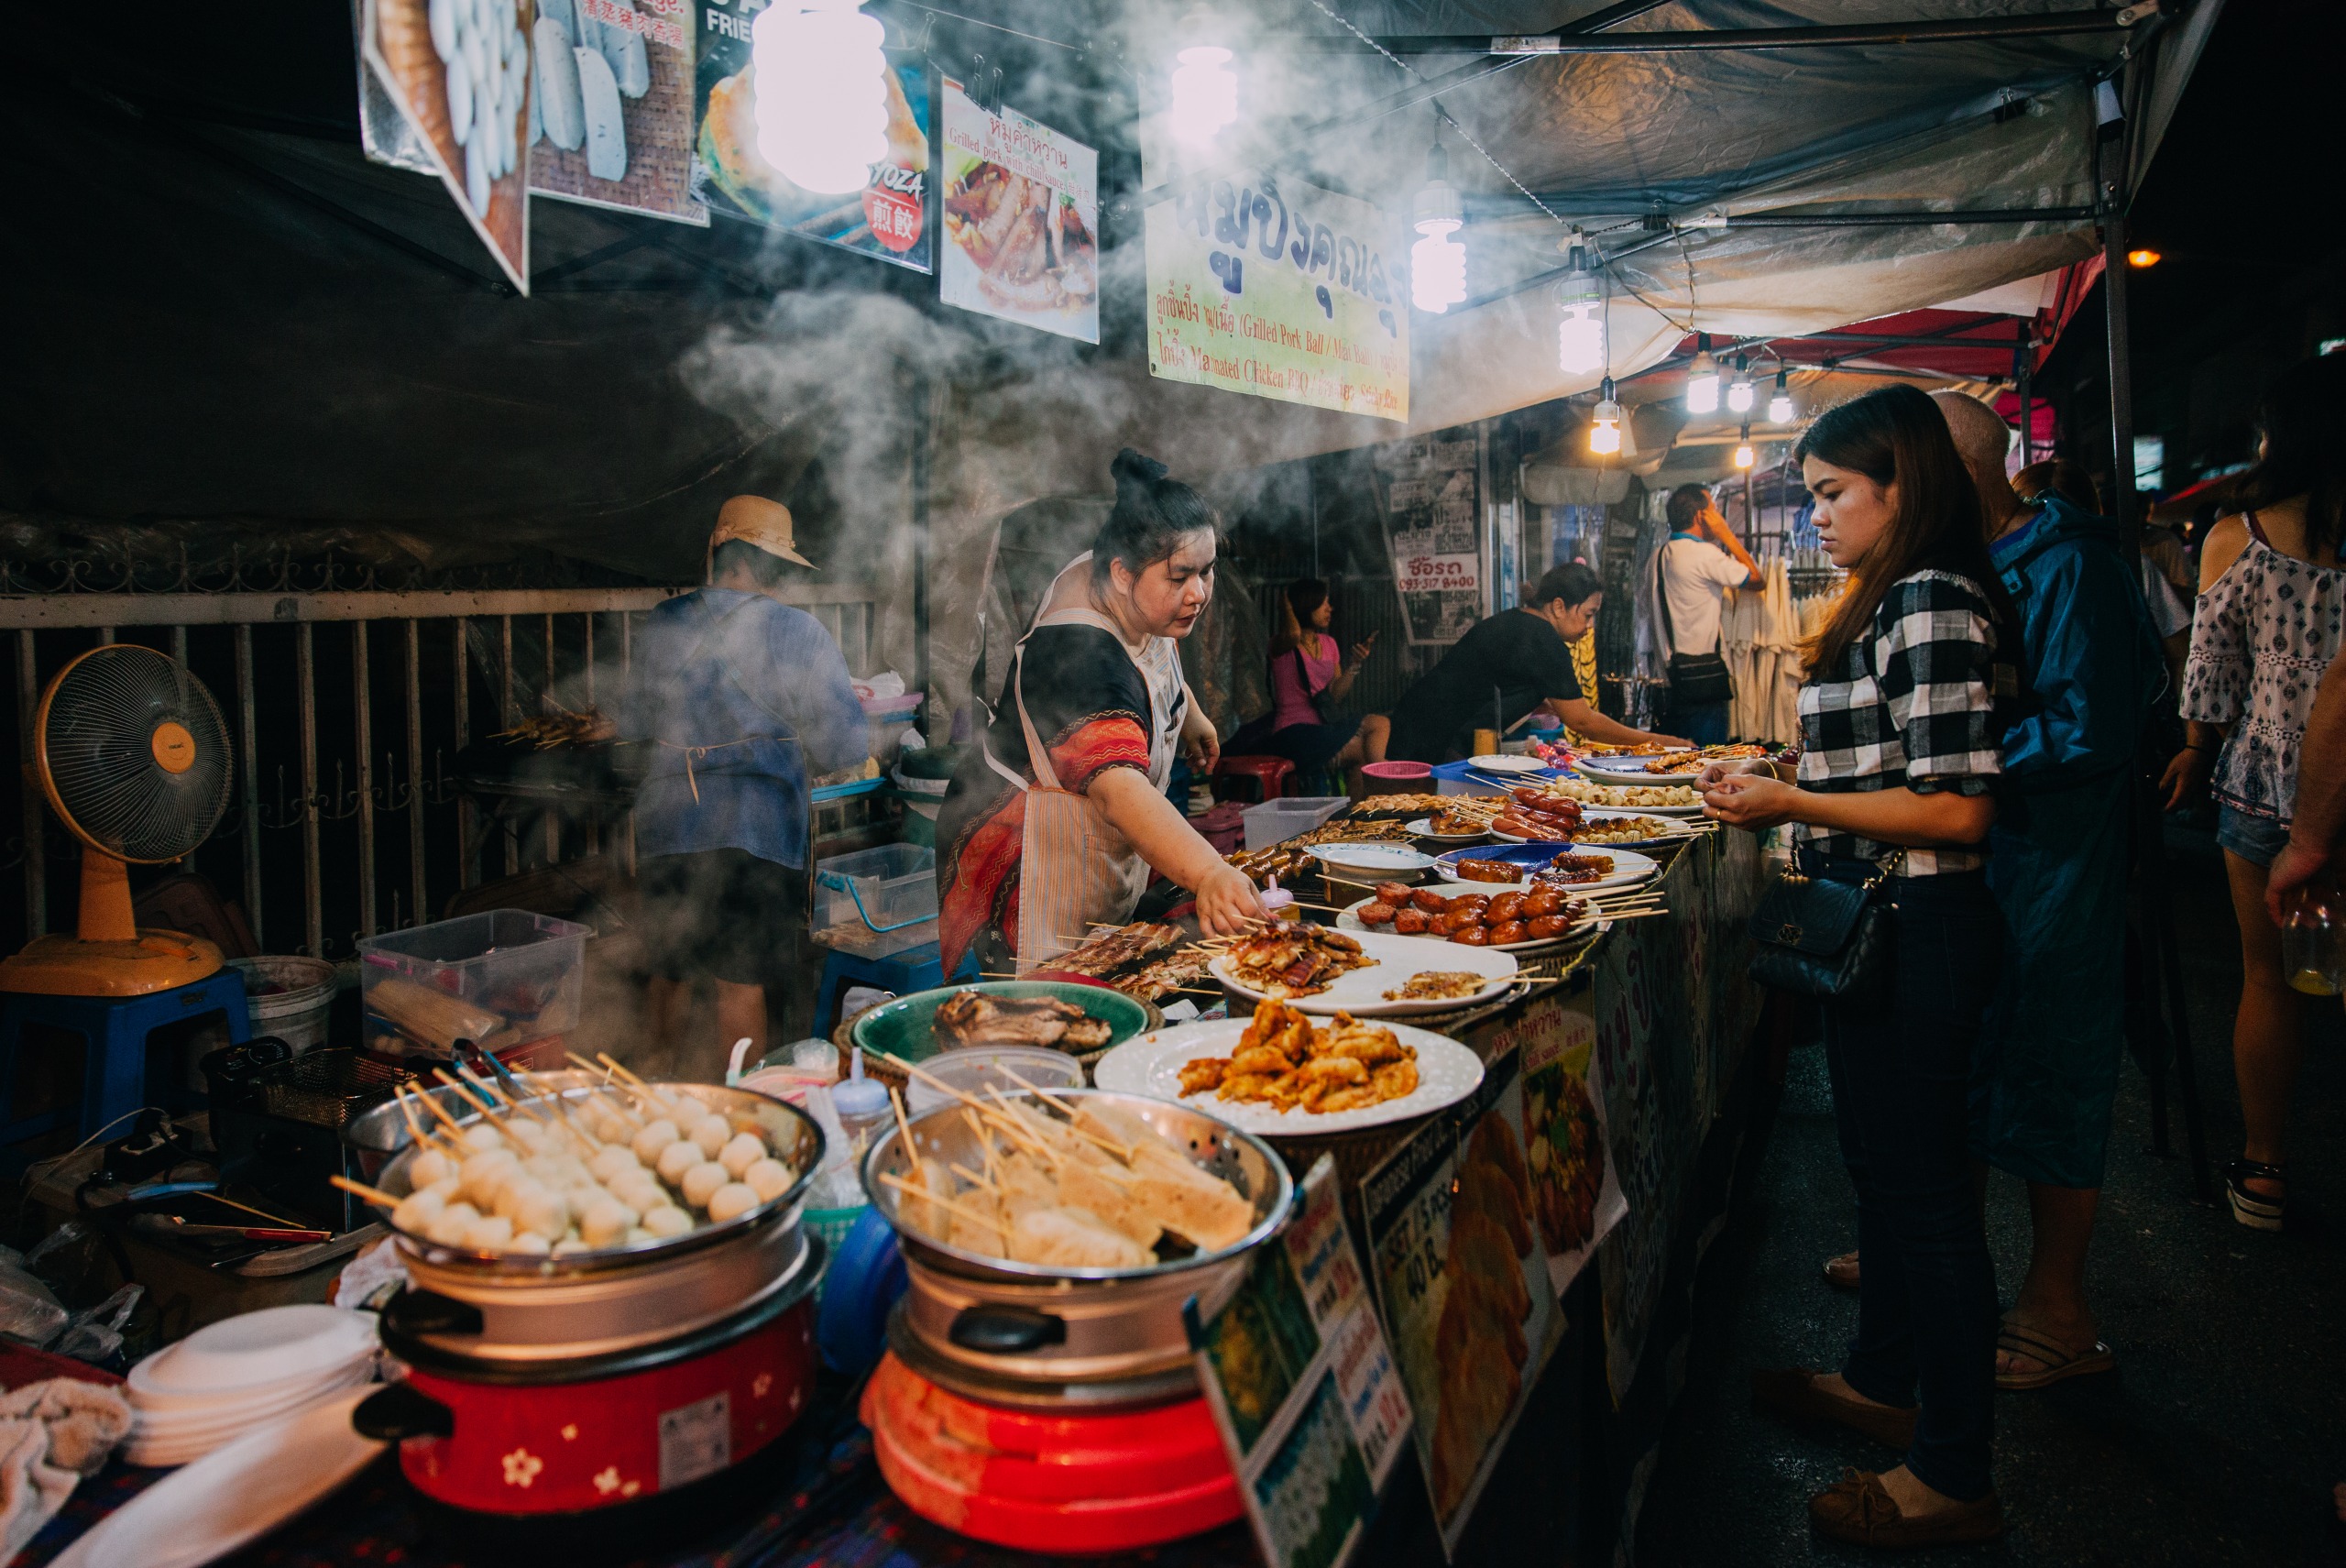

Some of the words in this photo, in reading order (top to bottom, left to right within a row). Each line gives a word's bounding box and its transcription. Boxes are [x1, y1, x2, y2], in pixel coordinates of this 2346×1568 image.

[706, 7, 754, 44] FRIE
[949, 126, 980, 153] Grilled
[983, 146, 1003, 163] pork
[1005, 154, 1024, 172] with
[1025, 163, 1042, 181] chili
[869, 163, 925, 207] YOZA
[1239, 313, 1277, 343] (Grilled
[1280, 323, 1301, 350] Pork
[1306, 330, 1324, 355] Ball
[1332, 337, 1352, 362] Meat
[1244, 358, 1284, 389] Chicken
